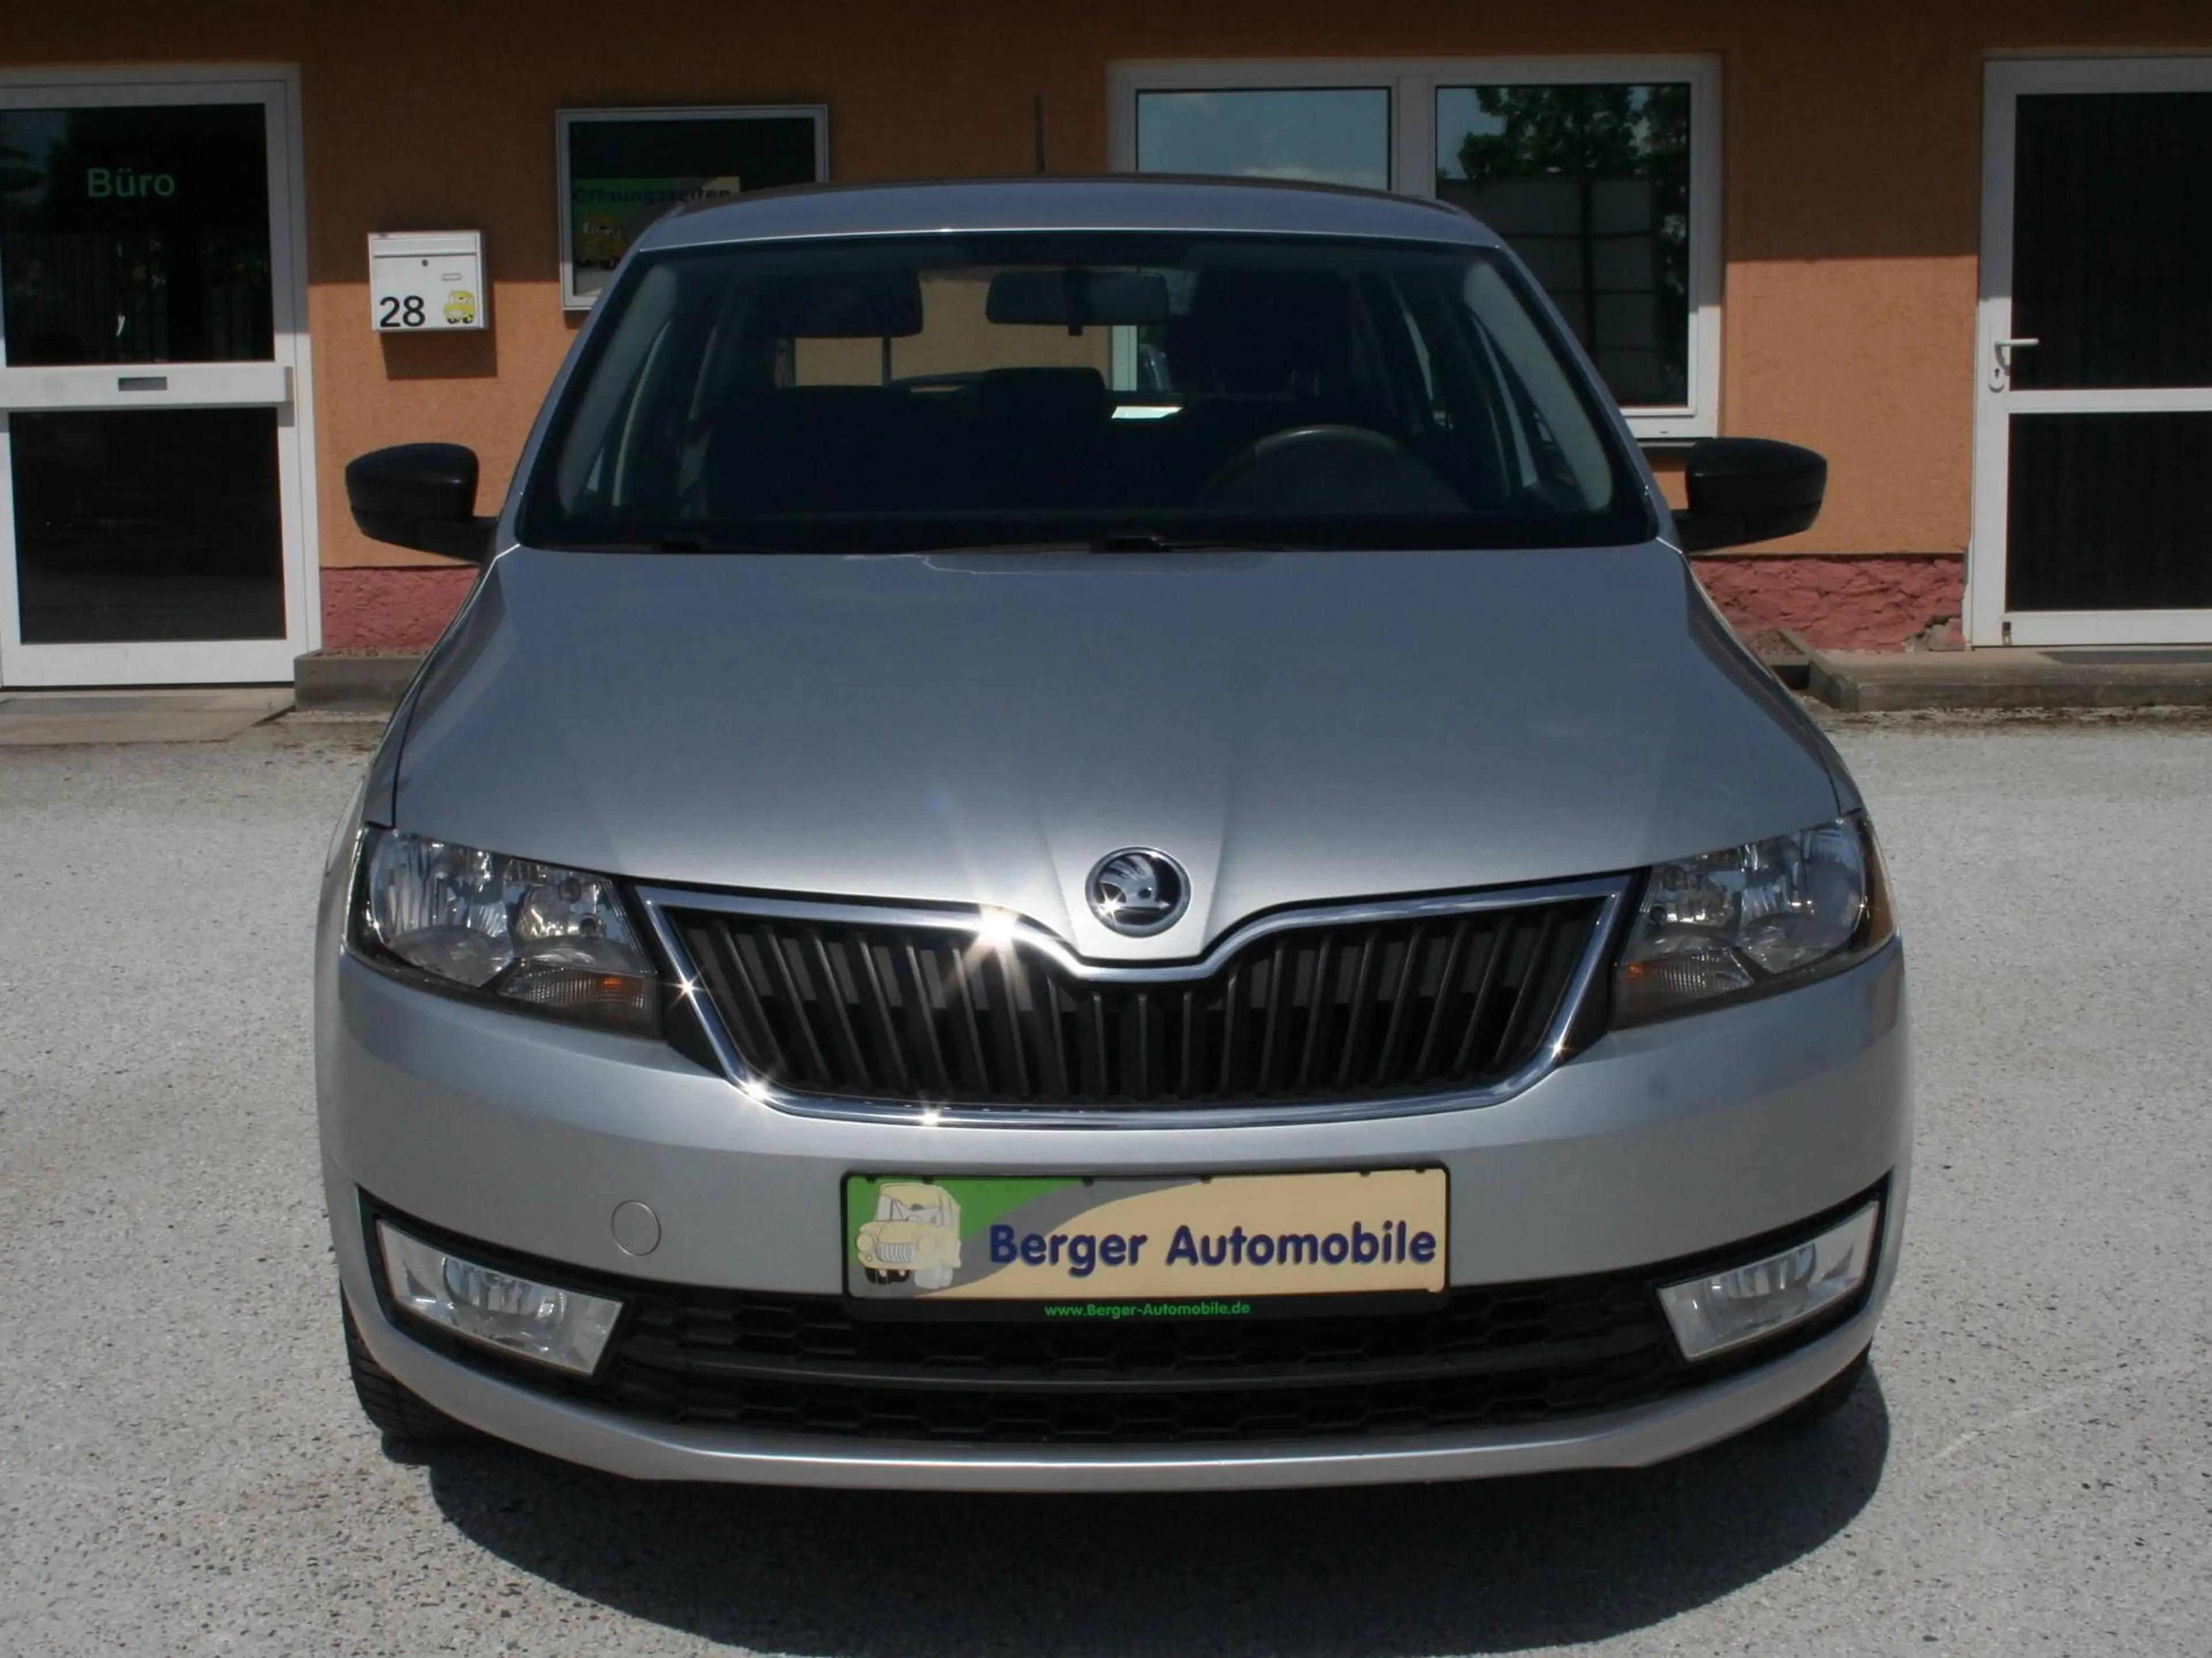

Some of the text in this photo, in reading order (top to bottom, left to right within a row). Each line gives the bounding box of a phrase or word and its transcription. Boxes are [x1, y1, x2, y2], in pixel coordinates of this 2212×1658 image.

[87, 166, 175, 198] Büro
[380, 295, 426, 328] 28
[990, 1219, 1437, 1278] Berger Automobile
[1044, 1301, 1250, 1319] www.Berger-Automobile.de
